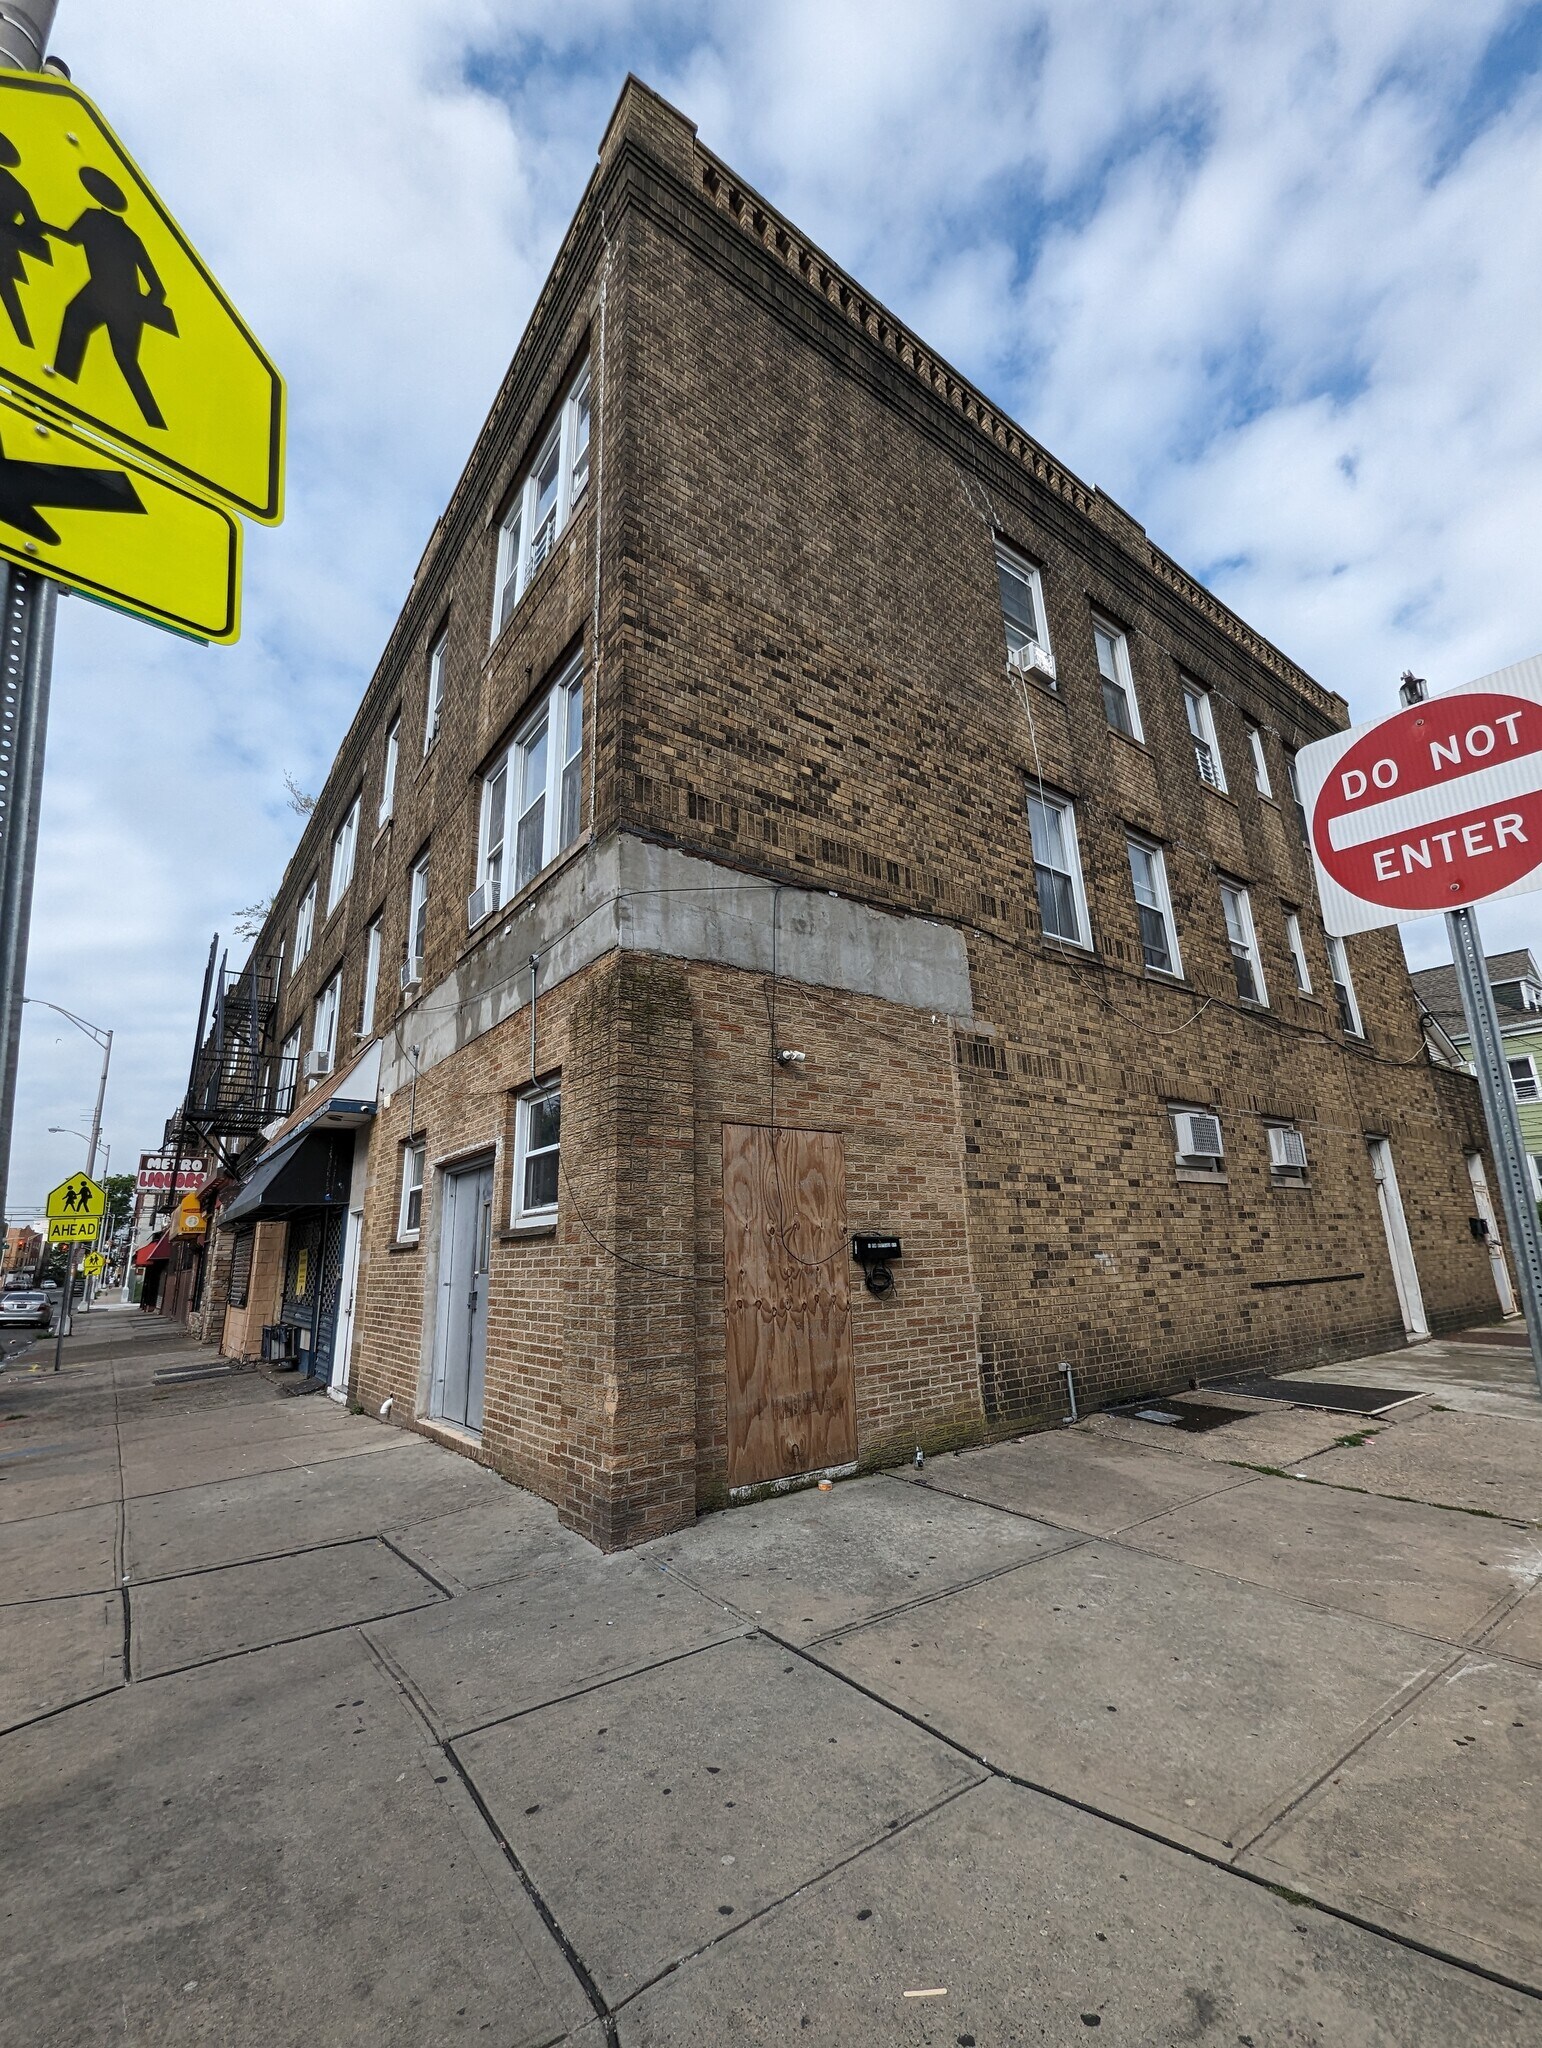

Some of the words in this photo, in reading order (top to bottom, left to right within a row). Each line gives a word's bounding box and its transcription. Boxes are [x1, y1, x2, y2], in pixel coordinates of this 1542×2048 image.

[1341, 758, 1398, 801] DO
[1429, 711, 1522, 771] NOT
[1373, 813, 1528, 881] ENTER
[51, 1223, 96, 1236] AHEAD
